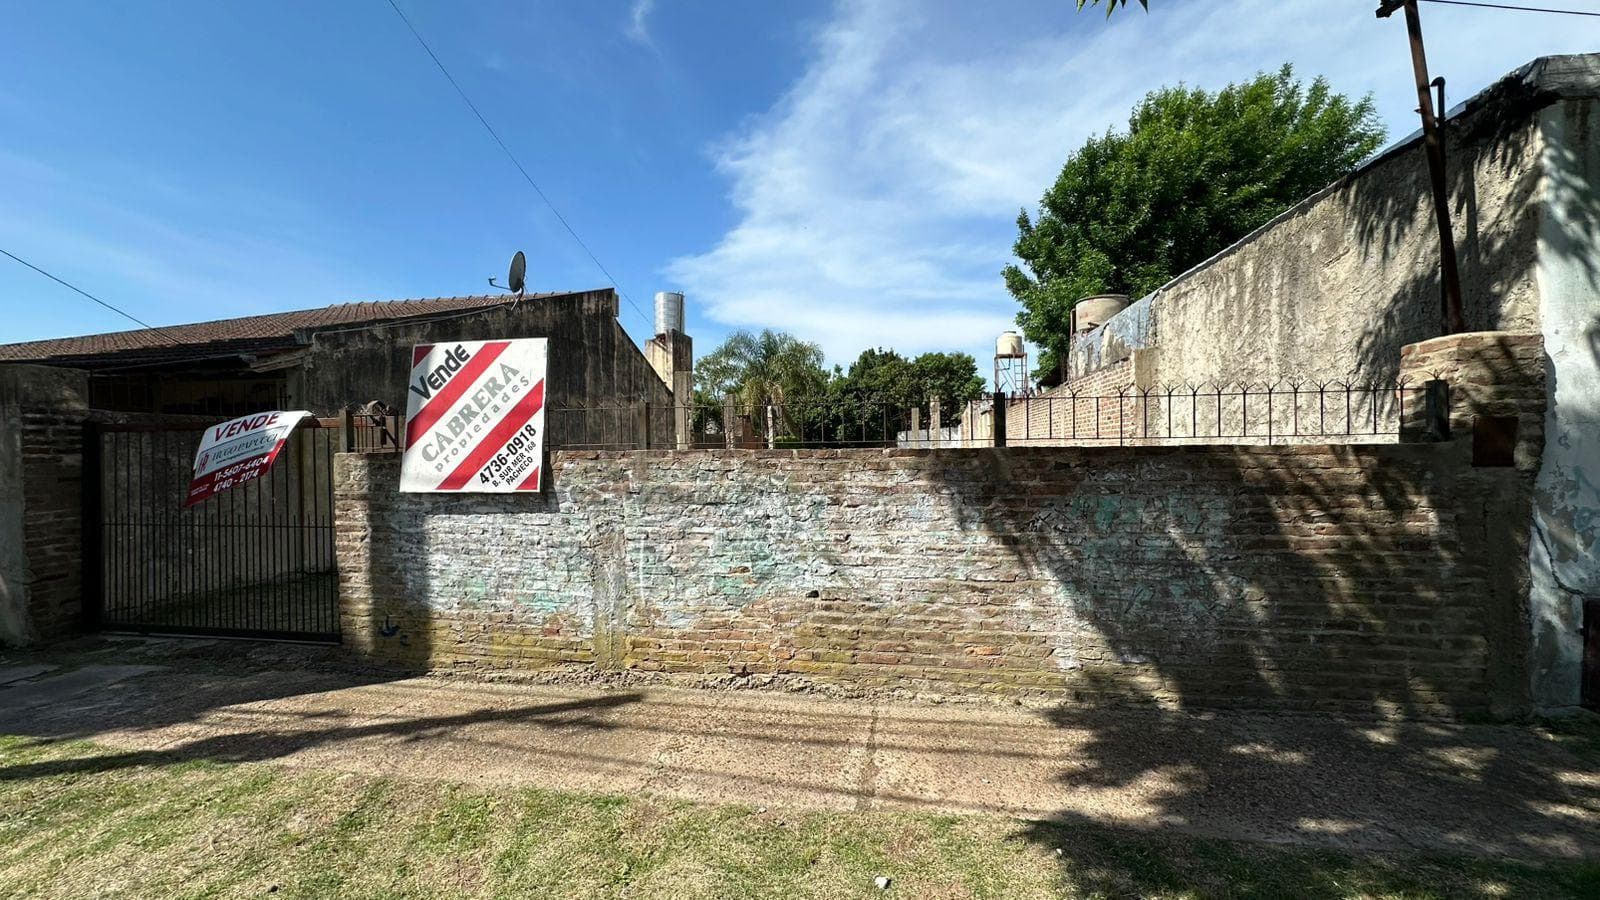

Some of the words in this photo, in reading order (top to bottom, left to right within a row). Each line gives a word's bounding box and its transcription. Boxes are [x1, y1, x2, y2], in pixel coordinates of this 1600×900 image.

[410, 344, 471, 400] Vende
[215, 412, 280, 442] VENDE
[421, 363, 520, 462] CABRERA
[435, 376, 529, 472] propiedades
[479, 424, 537, 485] 4736-0918
[500, 467, 514, 482] SUR
[512, 452, 526, 468] MER
[506, 456, 533, 486] PACHECO
